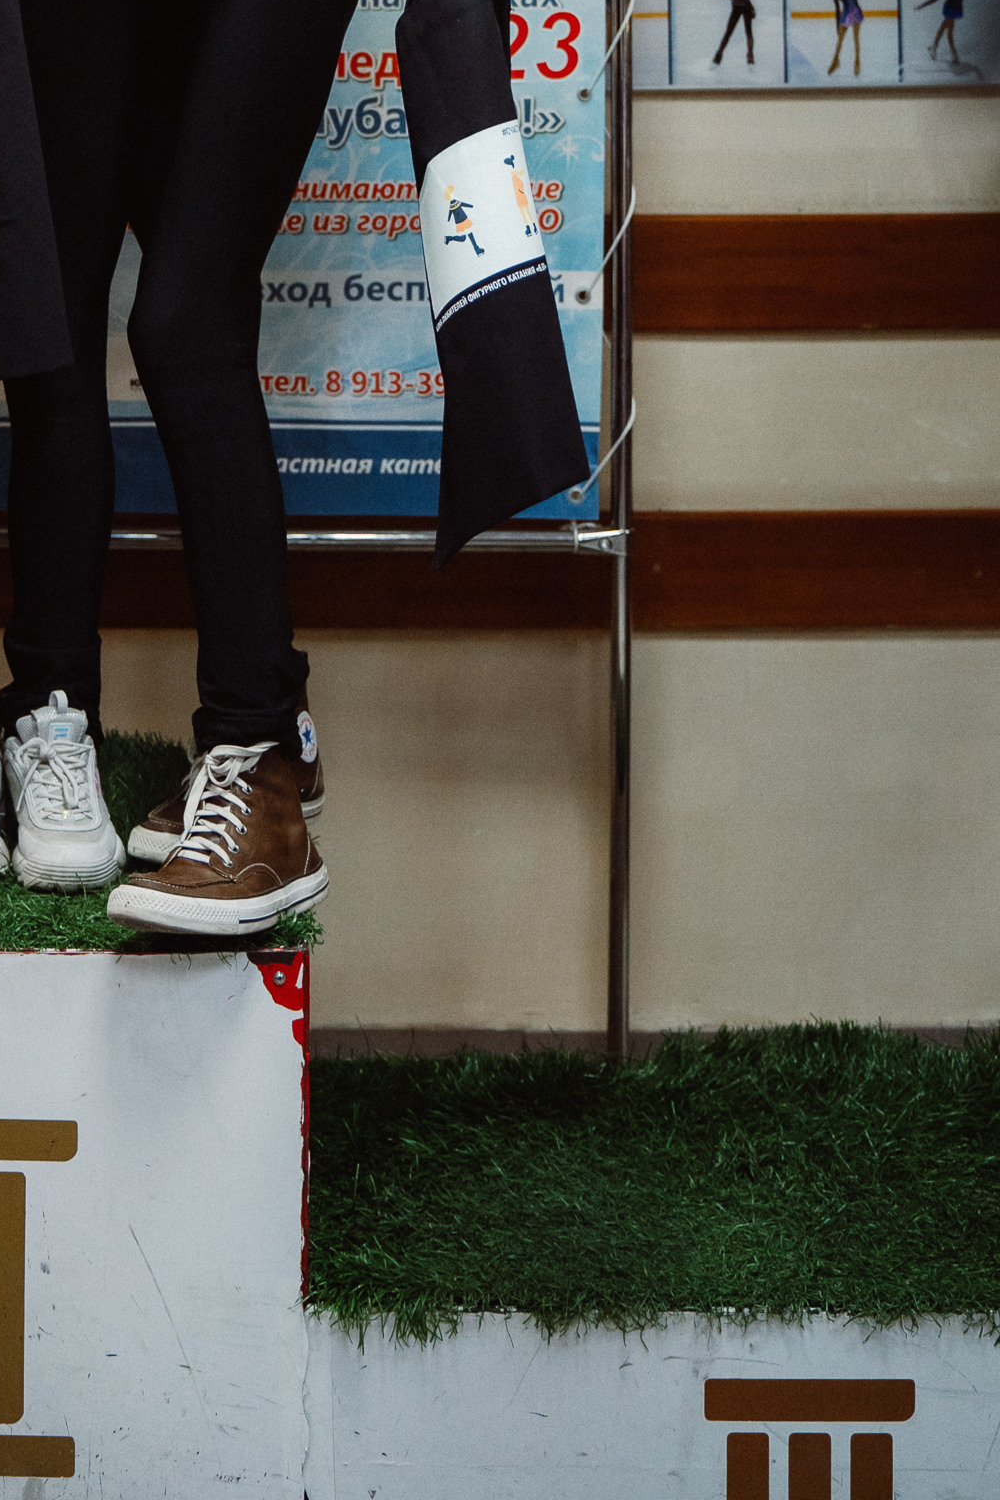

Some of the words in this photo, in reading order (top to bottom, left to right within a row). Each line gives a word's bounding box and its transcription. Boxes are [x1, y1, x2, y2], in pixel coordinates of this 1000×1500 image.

[313, 214, 352, 233] из
[260, 280, 333, 309] ход
[467, 276, 508, 303] ФИГУРНОГО
[506, 265, 537, 284] КАТАНИЯ
[261, 374, 317, 394] тел.
[325, 370, 342, 394] 8
